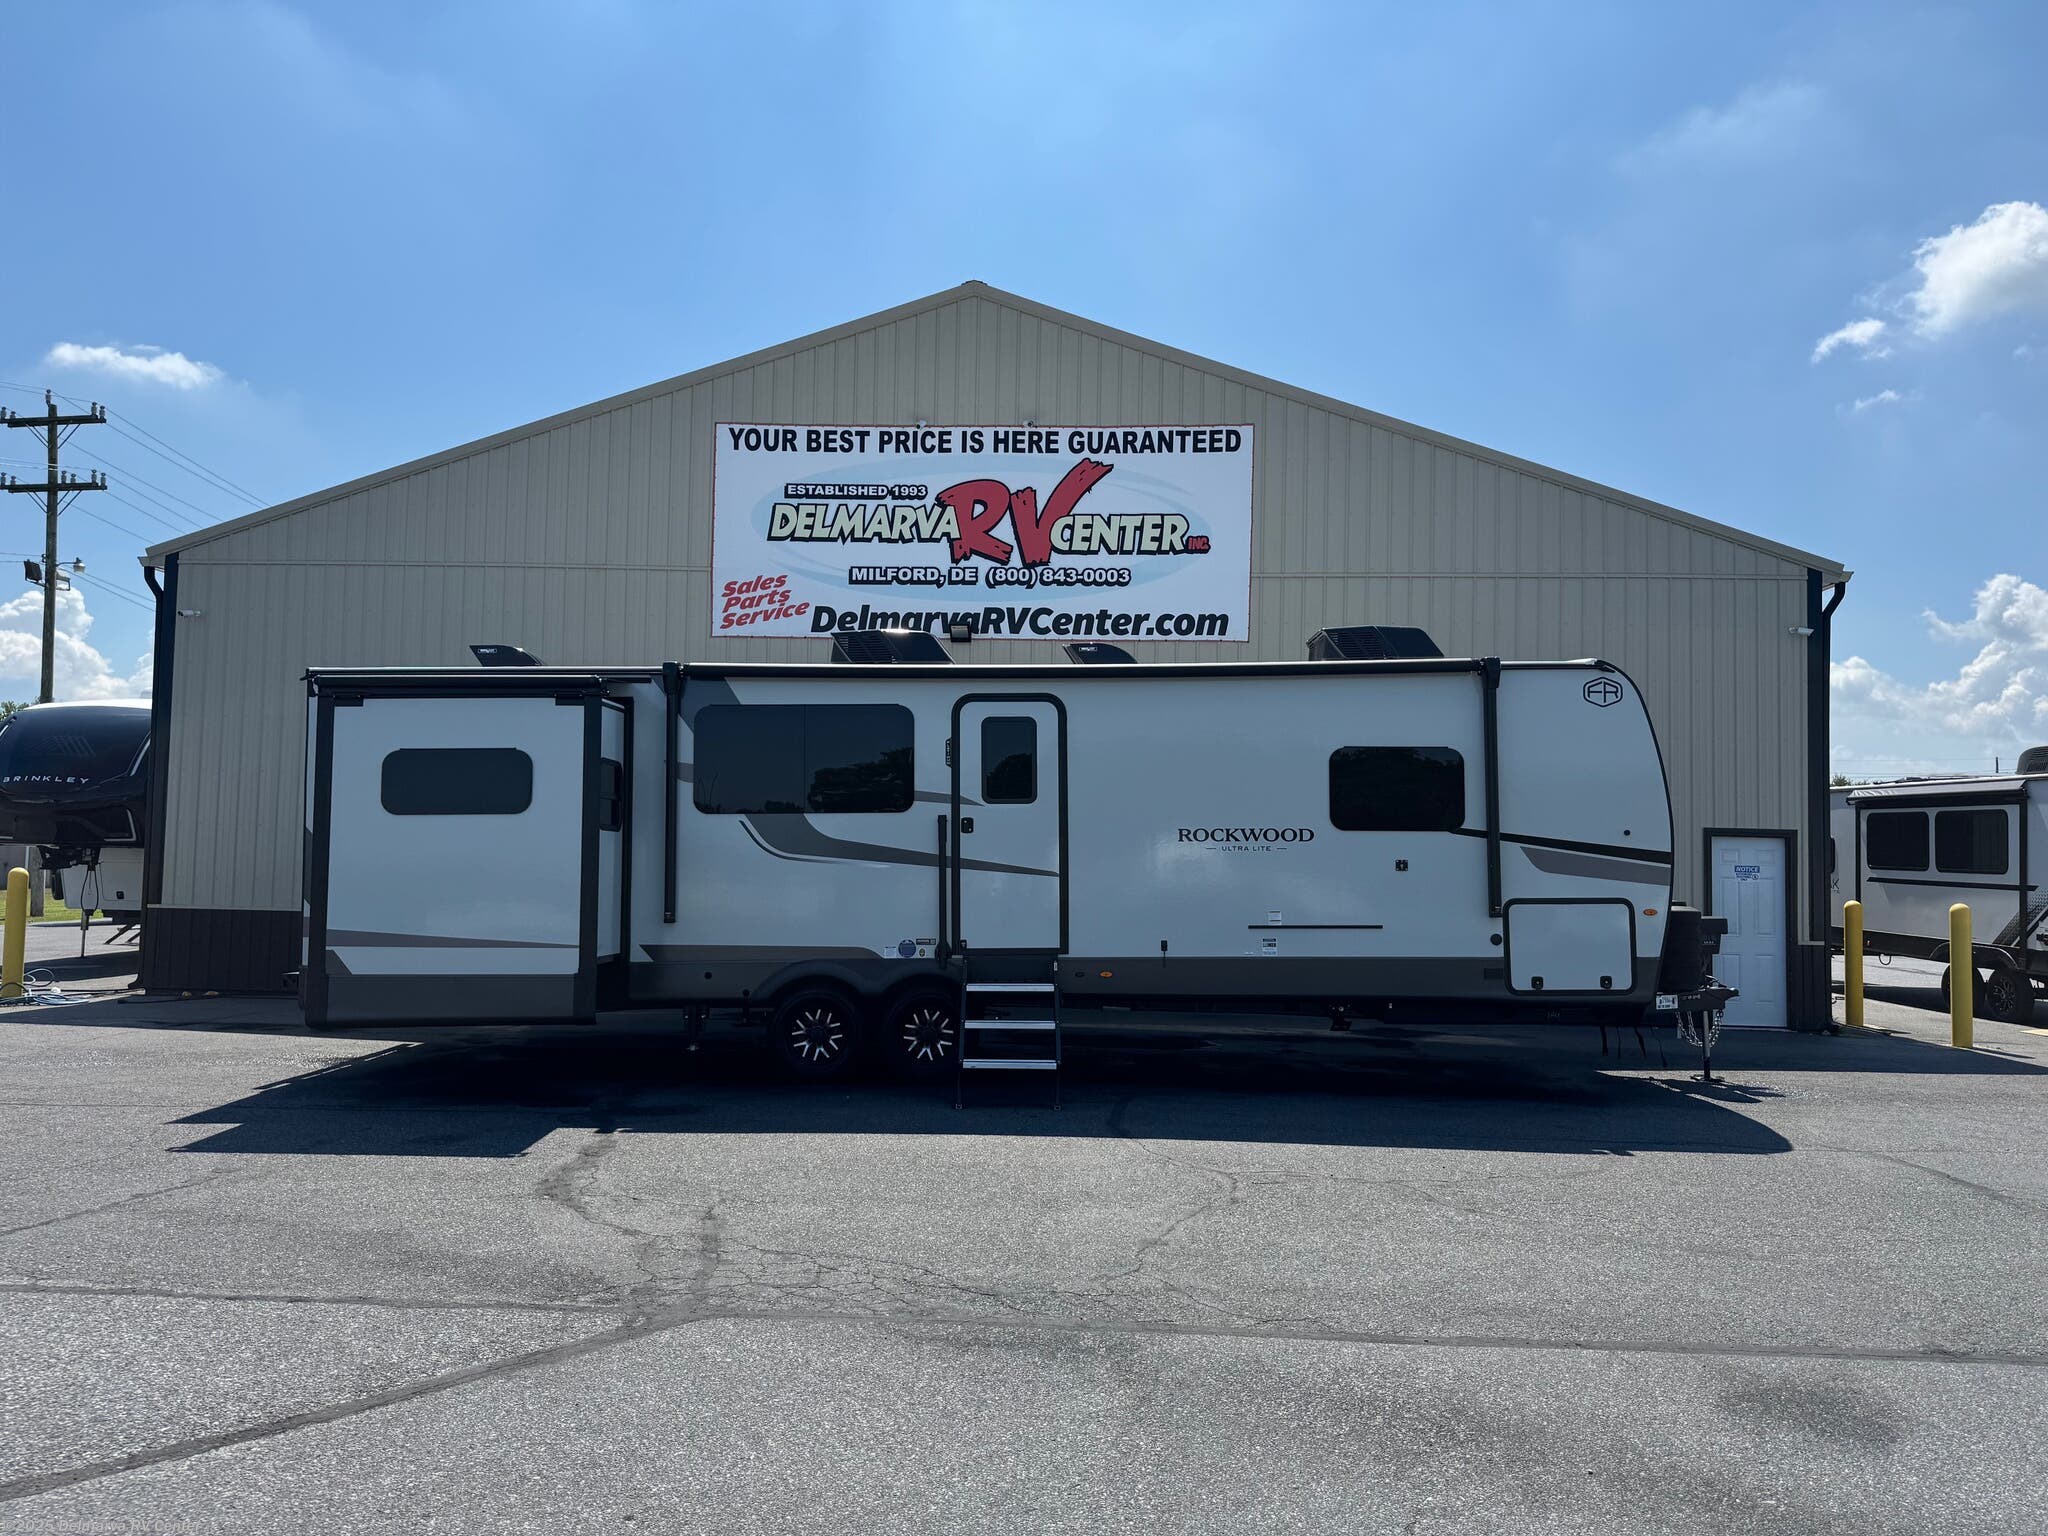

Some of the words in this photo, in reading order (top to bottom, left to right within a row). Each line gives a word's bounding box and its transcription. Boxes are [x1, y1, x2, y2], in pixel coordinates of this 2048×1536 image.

[729, 427, 798, 452] YOUR
[806, 429, 870, 453] BEST
[878, 430, 951, 454] PRICE
[961, 430, 984, 454] IS
[993, 430, 1059, 454] HERE
[1068, 429, 1242, 454] GUARANTEED
[786, 484, 889, 498] ESTABLISHED
[891, 485, 928, 499] 1993
[767, 502, 960, 543] DELMARVA
[936, 457, 1114, 567] RV
[1050, 513, 1190, 556] CENTER
[721, 574, 788, 598] Sales
[850, 566, 946, 587] MILFORD,
[950, 567, 978, 585] DE
[987, 567, 1038, 588] (800)
[1042, 567, 1131, 586] 843-0003
[722, 588, 791, 614] Parts
[720, 602, 810, 629] Service
[811, 605, 1229, 637] DelmarvaRVCenter.com
[3, 775, 89, 784] BRINKLEY
[1177, 827, 1315, 842] ROCKWOOD
